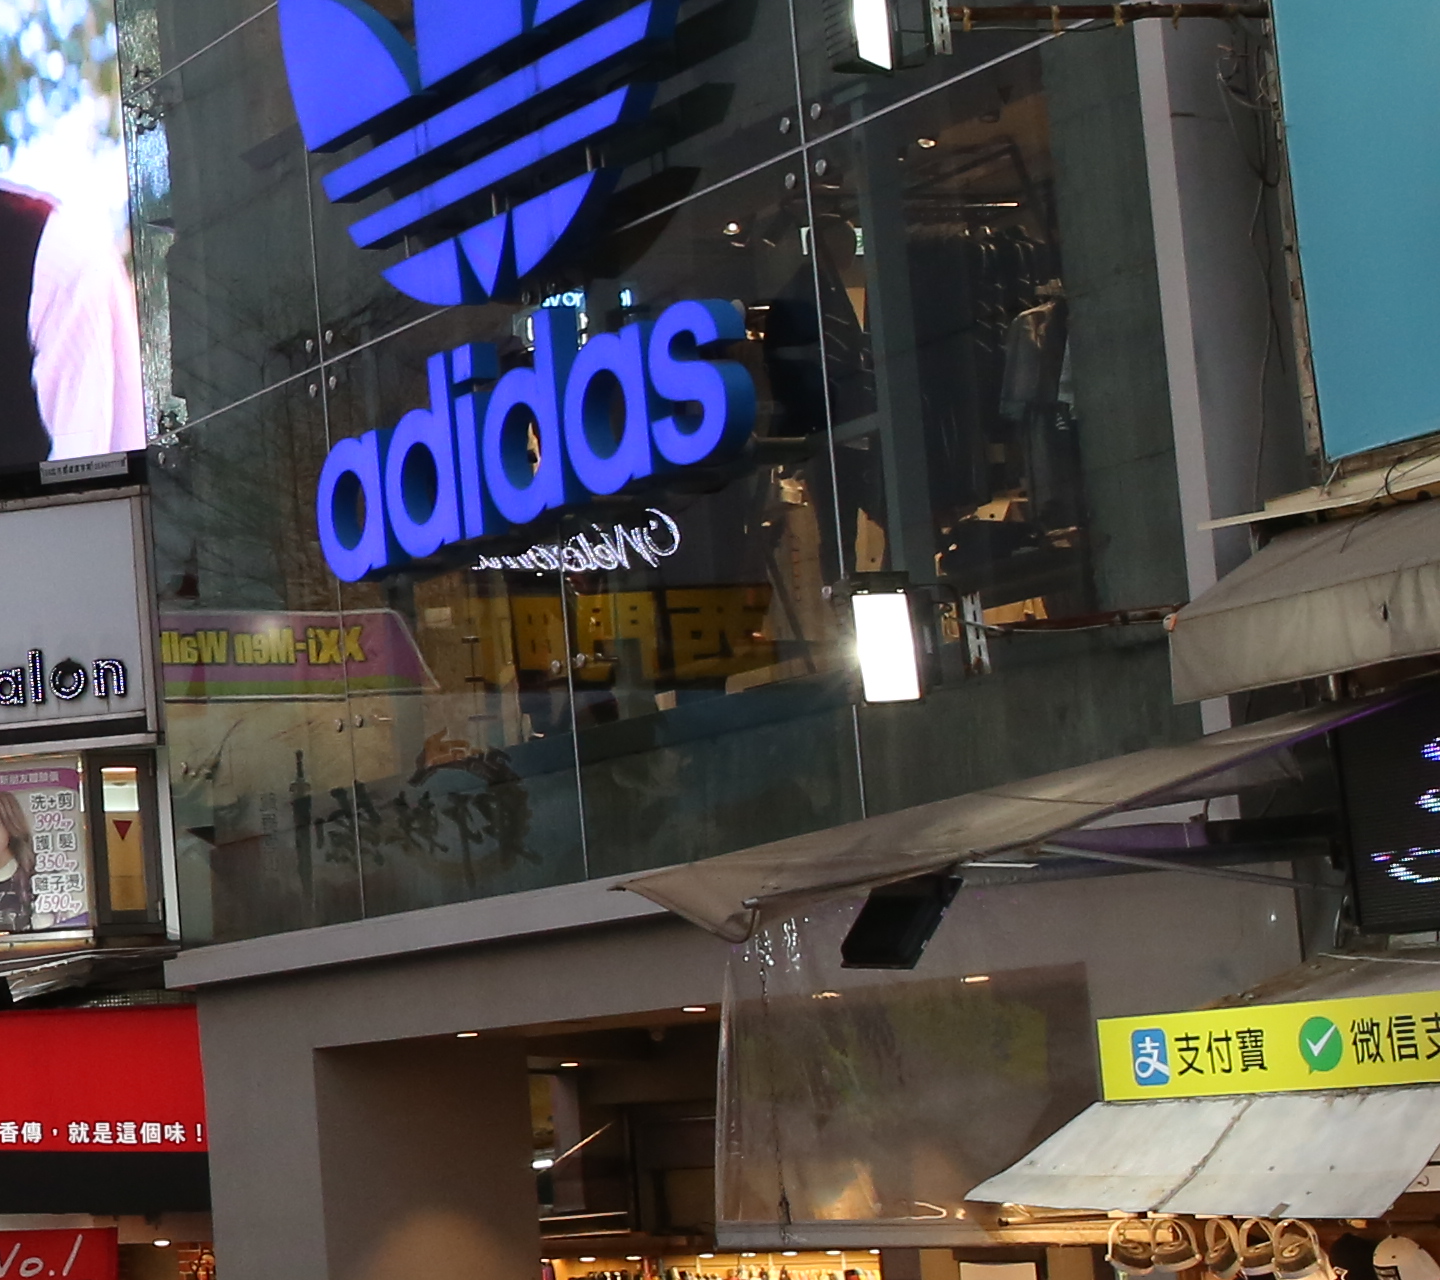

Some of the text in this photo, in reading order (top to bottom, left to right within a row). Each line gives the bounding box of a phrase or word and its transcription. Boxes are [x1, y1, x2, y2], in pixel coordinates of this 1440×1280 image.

[316, 300, 742, 581] adidas
[1174, 1027, 1268, 1078] 支付寶
